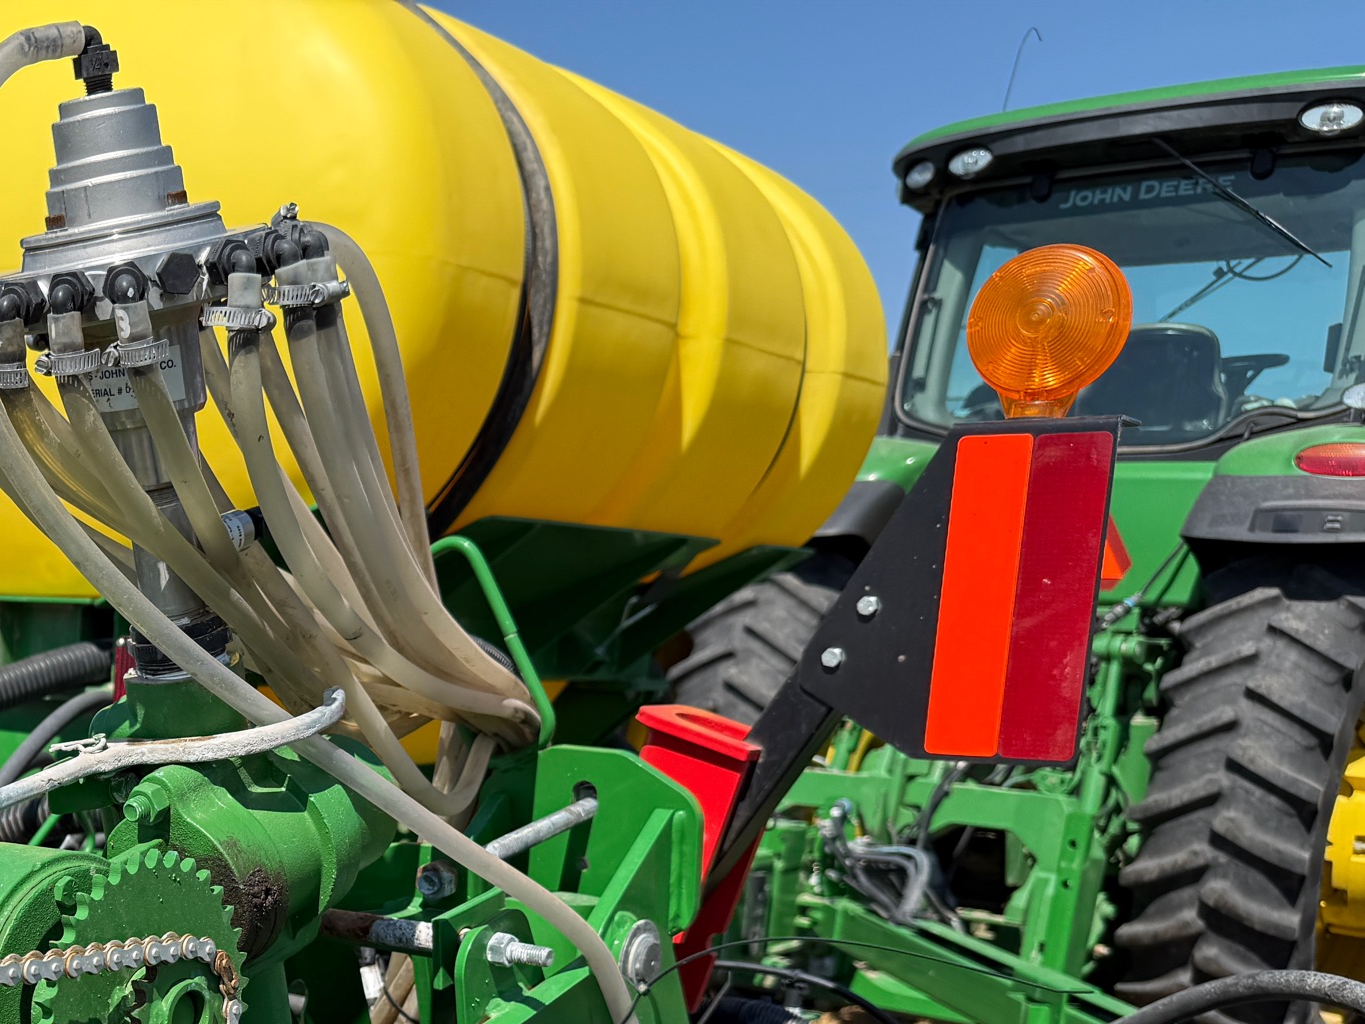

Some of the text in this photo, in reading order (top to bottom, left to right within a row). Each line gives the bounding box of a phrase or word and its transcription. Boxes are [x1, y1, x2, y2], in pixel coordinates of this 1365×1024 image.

[1059, 175, 1236, 209] JOHN DEERE
[99, 368, 126, 380] JOHN
[159, 359, 176, 370] CO.
[91, 387, 115, 398] ERIAL
